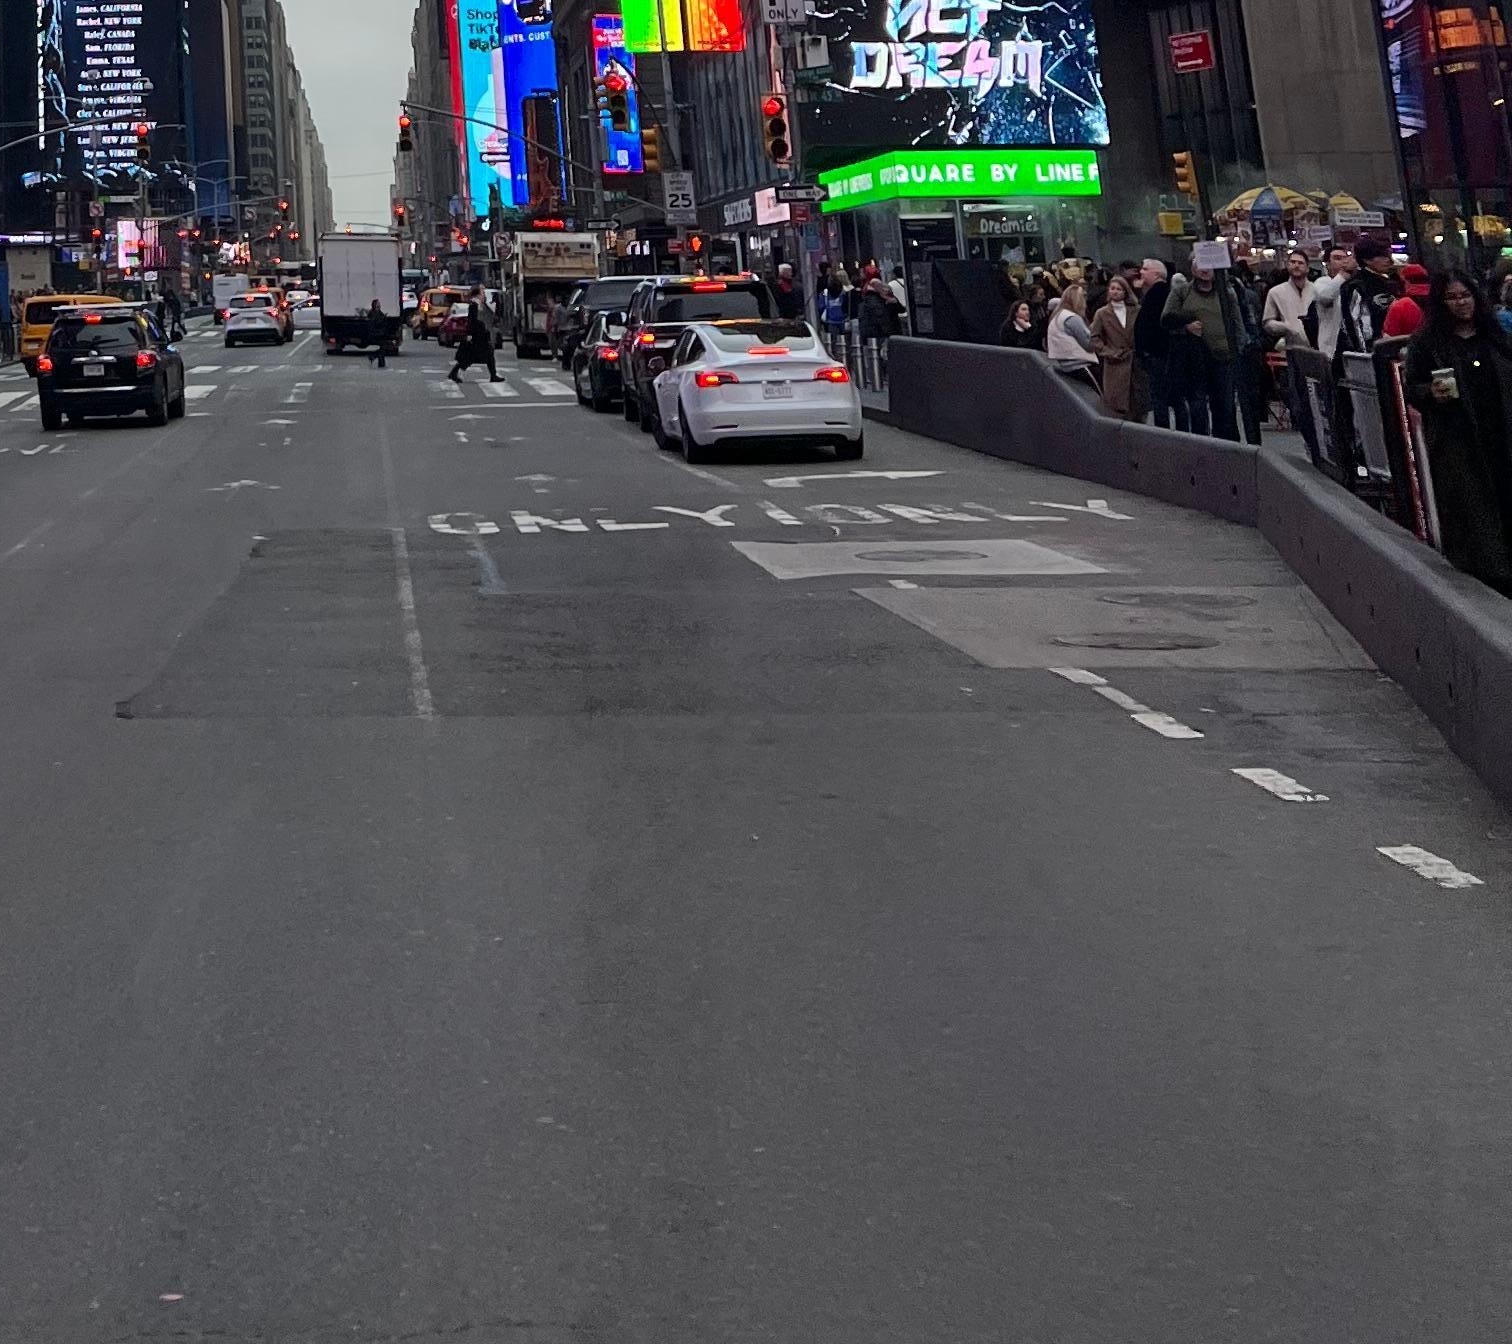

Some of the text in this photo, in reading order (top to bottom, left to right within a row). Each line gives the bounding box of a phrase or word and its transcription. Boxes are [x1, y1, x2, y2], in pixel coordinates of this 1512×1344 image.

[769, 8, 799, 21] ONLY
[850, 40, 1045, 108] DREAM
[990, 164, 1085, 183] BY LINE
[668, 193, 693, 209] 25
